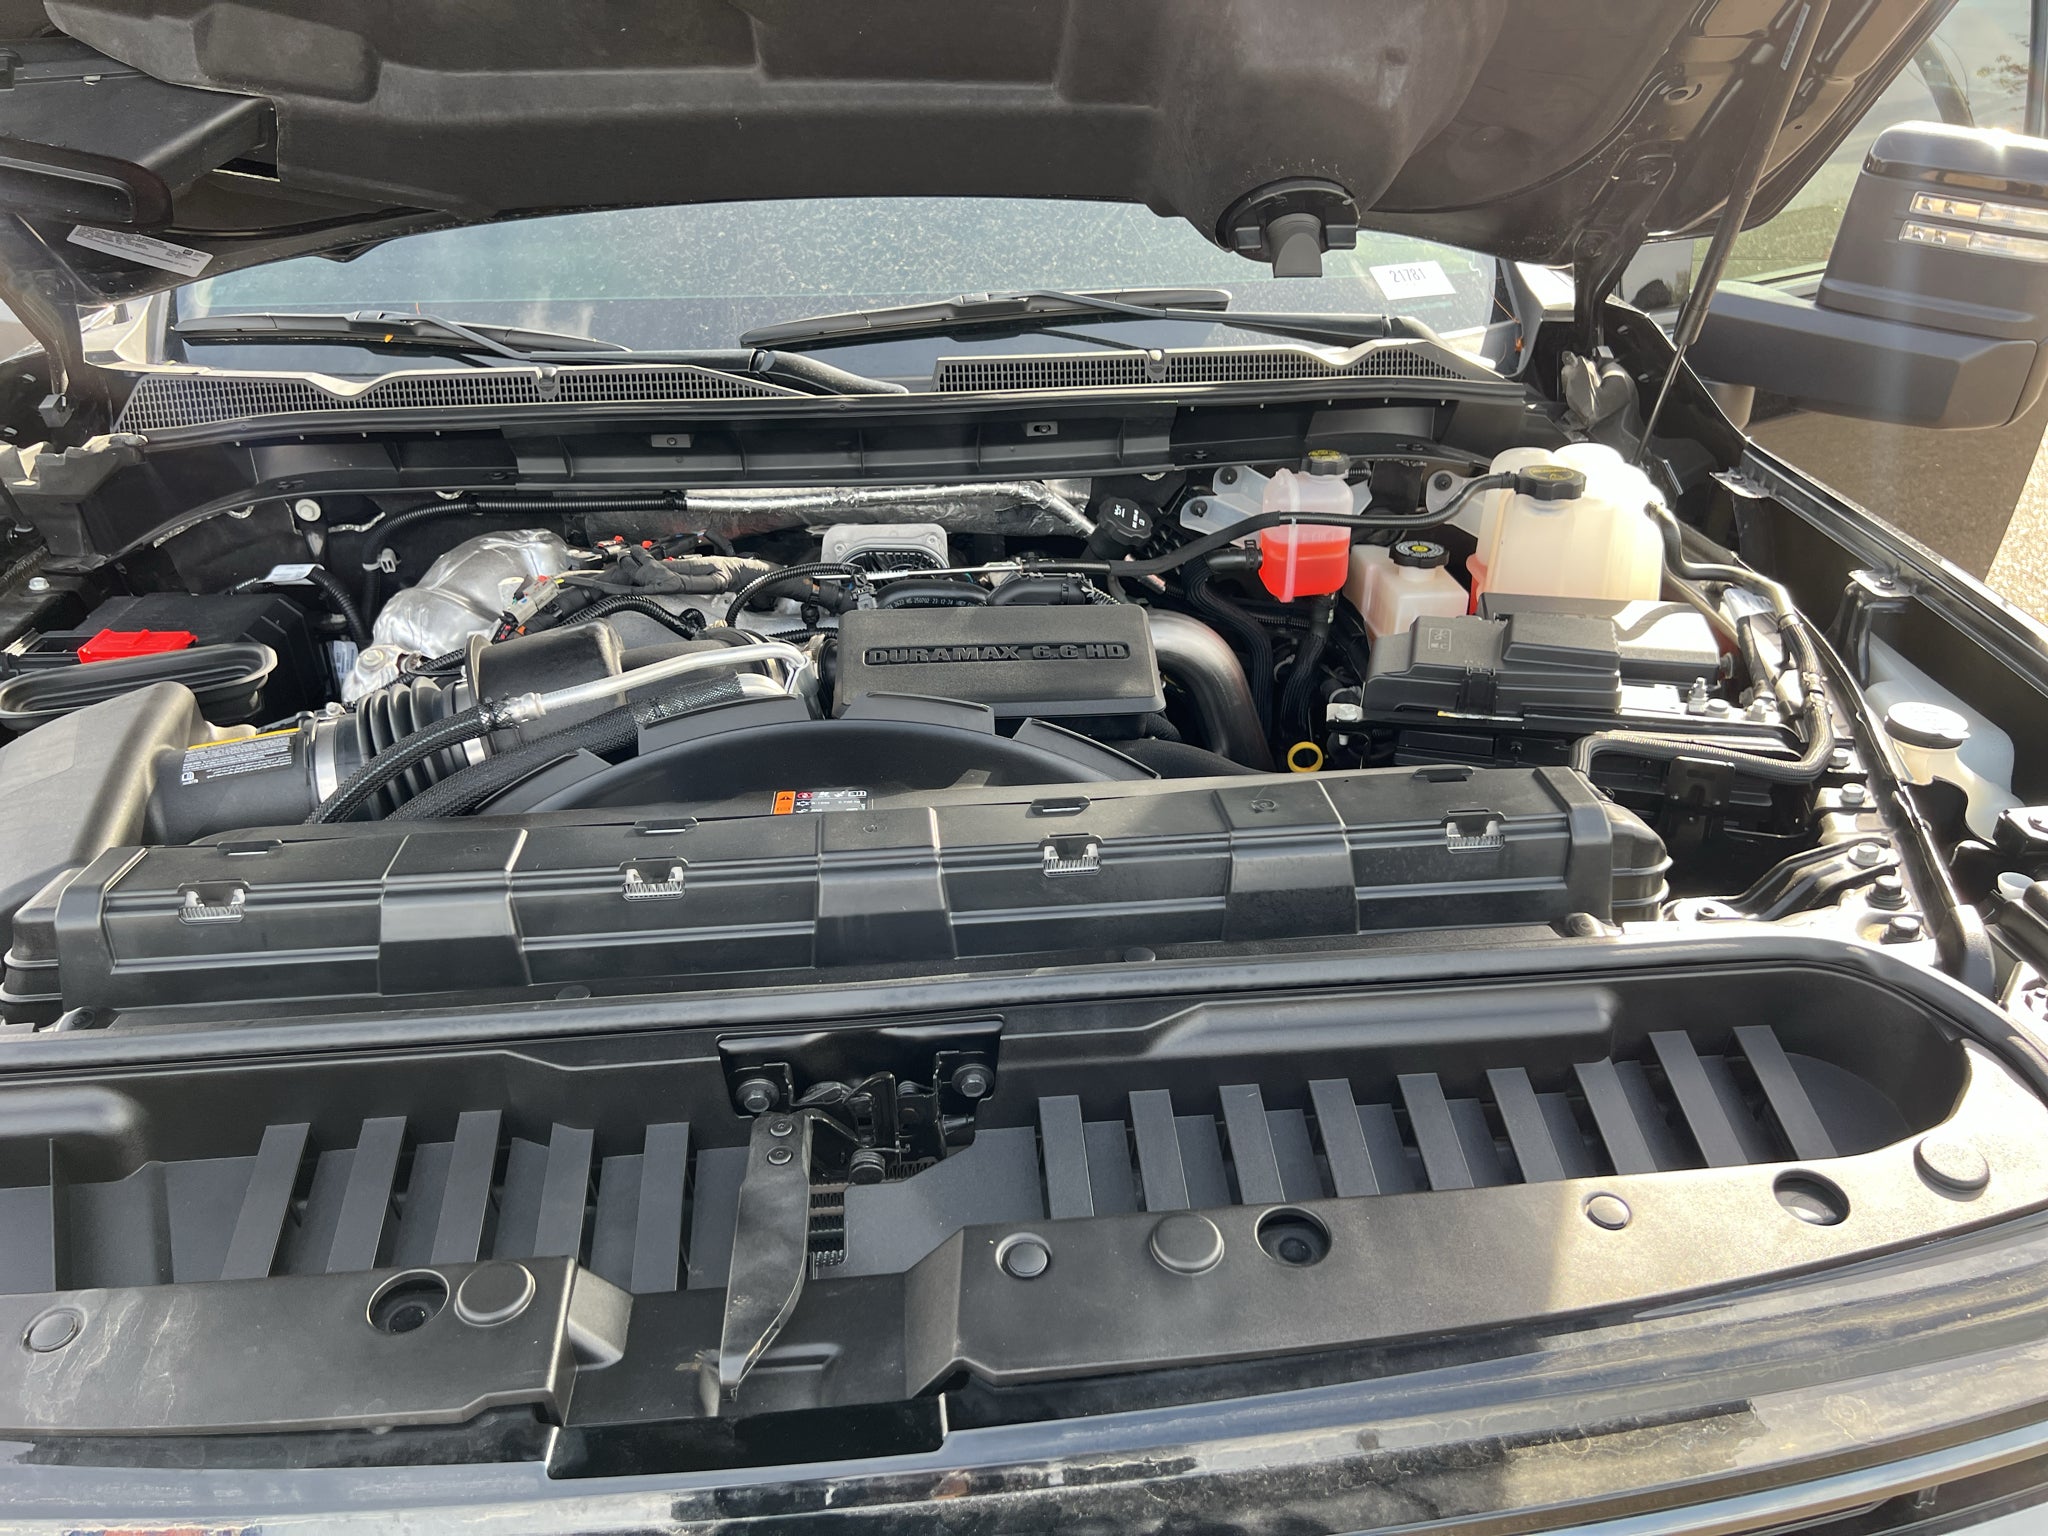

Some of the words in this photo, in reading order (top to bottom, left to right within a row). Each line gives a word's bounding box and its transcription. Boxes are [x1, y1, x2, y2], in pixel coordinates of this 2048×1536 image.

[868, 645, 1020, 663] DURAMAX
[1032, 645, 1079, 659] 6.6
[1085, 644, 1126, 659] HD
